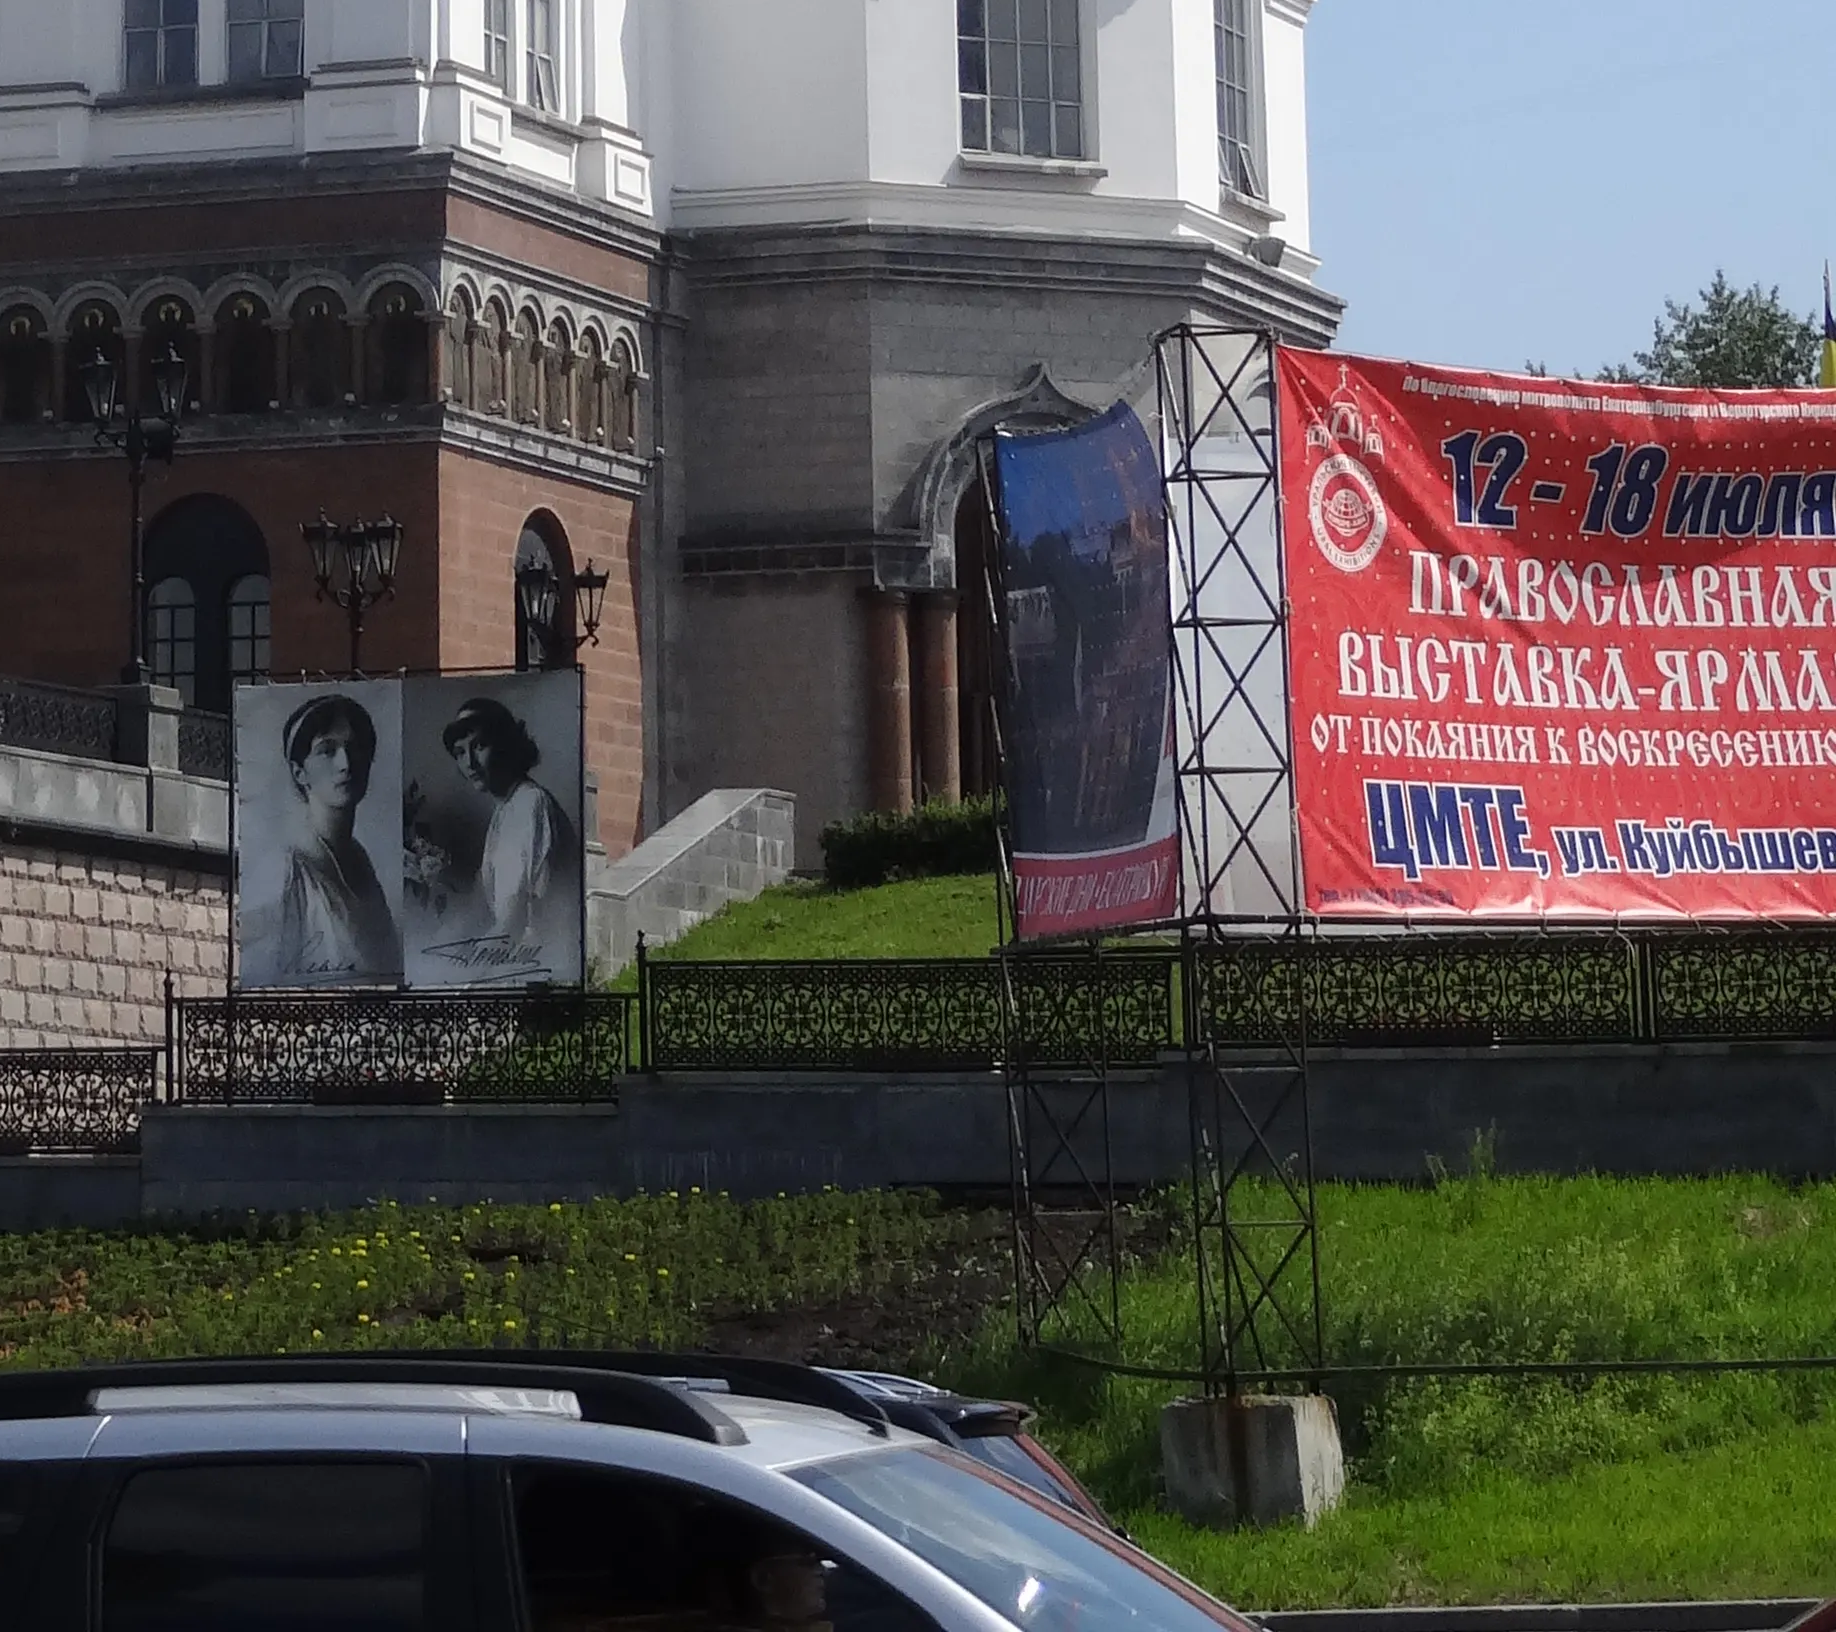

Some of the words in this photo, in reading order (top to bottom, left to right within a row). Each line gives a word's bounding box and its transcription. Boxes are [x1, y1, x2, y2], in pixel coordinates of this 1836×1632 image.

[1442, 429, 1528, 529] 12
[1580, 443, 1669, 538] 18
[1663, 471, 1836, 539] июля
[1409, 550, 1836, 628] ПРАВОСЛАВНАЯ
[1338, 631, 1836, 712] ВЫСТАВКА-ЯРМА
[1311, 713, 1352, 754] ОТ
[1360, 717, 1540, 764] ПОКАЯНИЯ
[1544, 727, 1572, 764] К
[1363, 778, 1551, 882] ЦМТЕ,
[1551, 826, 1620, 877] ул.
